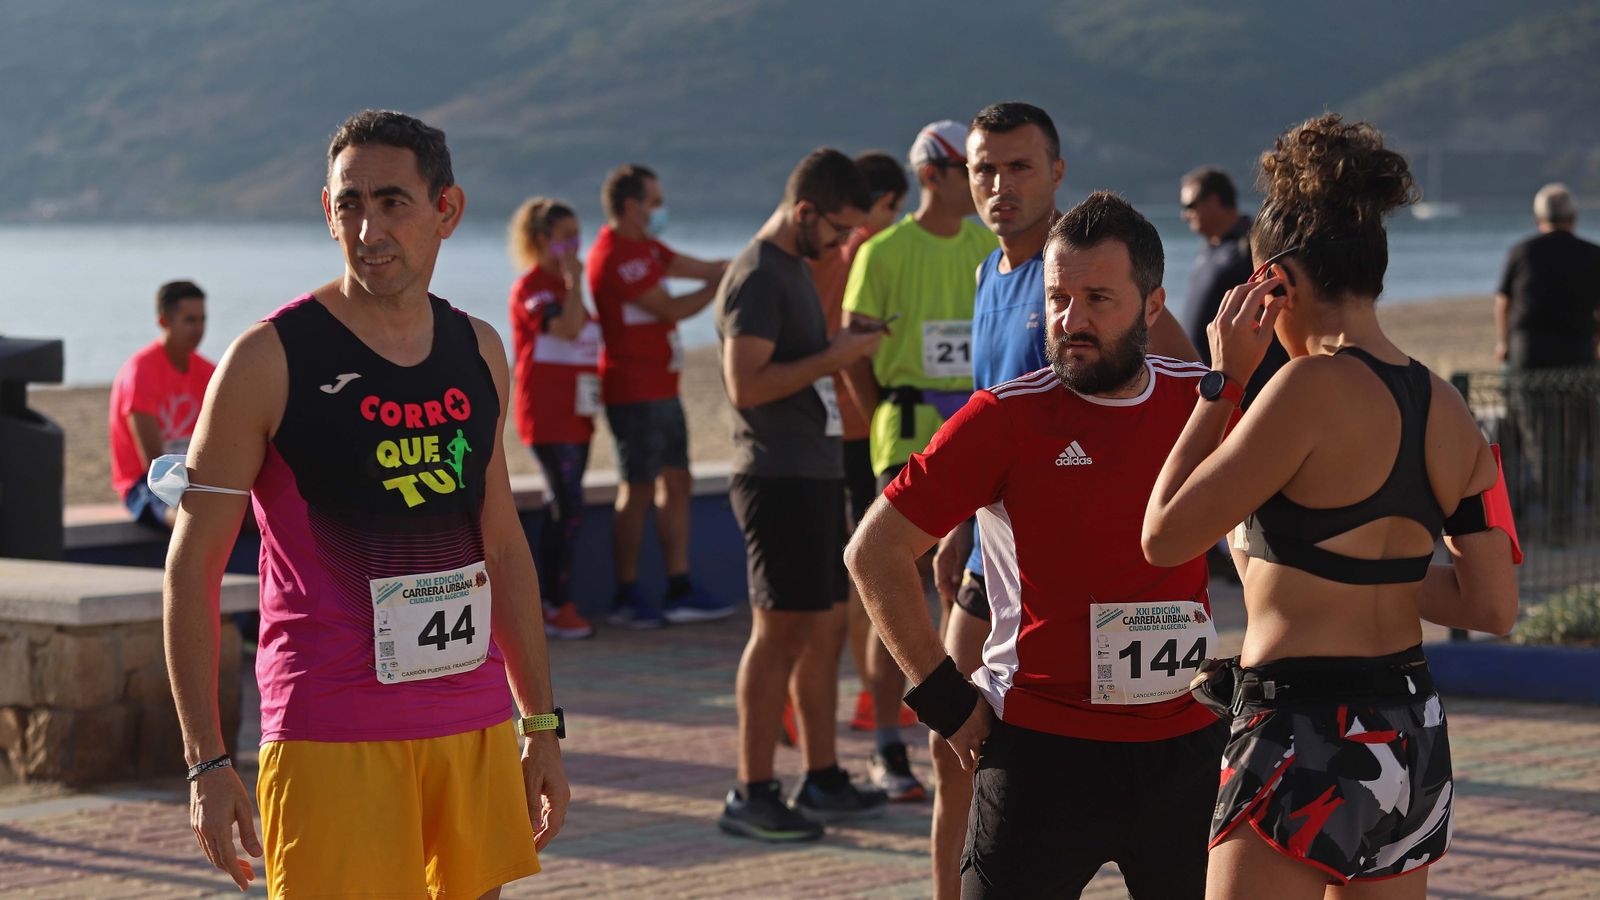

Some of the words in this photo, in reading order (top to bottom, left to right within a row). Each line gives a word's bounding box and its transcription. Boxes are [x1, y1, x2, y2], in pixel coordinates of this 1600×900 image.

[937, 341, 970, 363] 21
[360, 388, 471, 429] CORRO
[376, 435, 441, 468] QUE
[1055, 456, 1092, 466] adidas
[382, 468, 457, 508] TU
[402, 586, 446, 599] CARRERA
[445, 579, 473, 593] URBANA
[415, 579, 432, 588] XXI
[433, 572, 465, 586] EDICIÓN
[409, 596, 434, 605] CIUDAD
[444, 590, 470, 600] ALGECIRAS
[1122, 616, 1161, 625] CARRERA
[1162, 614, 1191, 624] URBANA
[1136, 607, 1150, 615] XXI
[1152, 605, 1181, 615] EDICIÓN
[418, 604, 476, 651] 44
[1161, 623, 1187, 631] ALGECIRAS
[1119, 637, 1207, 679] 144
[401, 669, 427, 678] CARRIÓN
[452, 659, 477, 669] FRANCISCO
